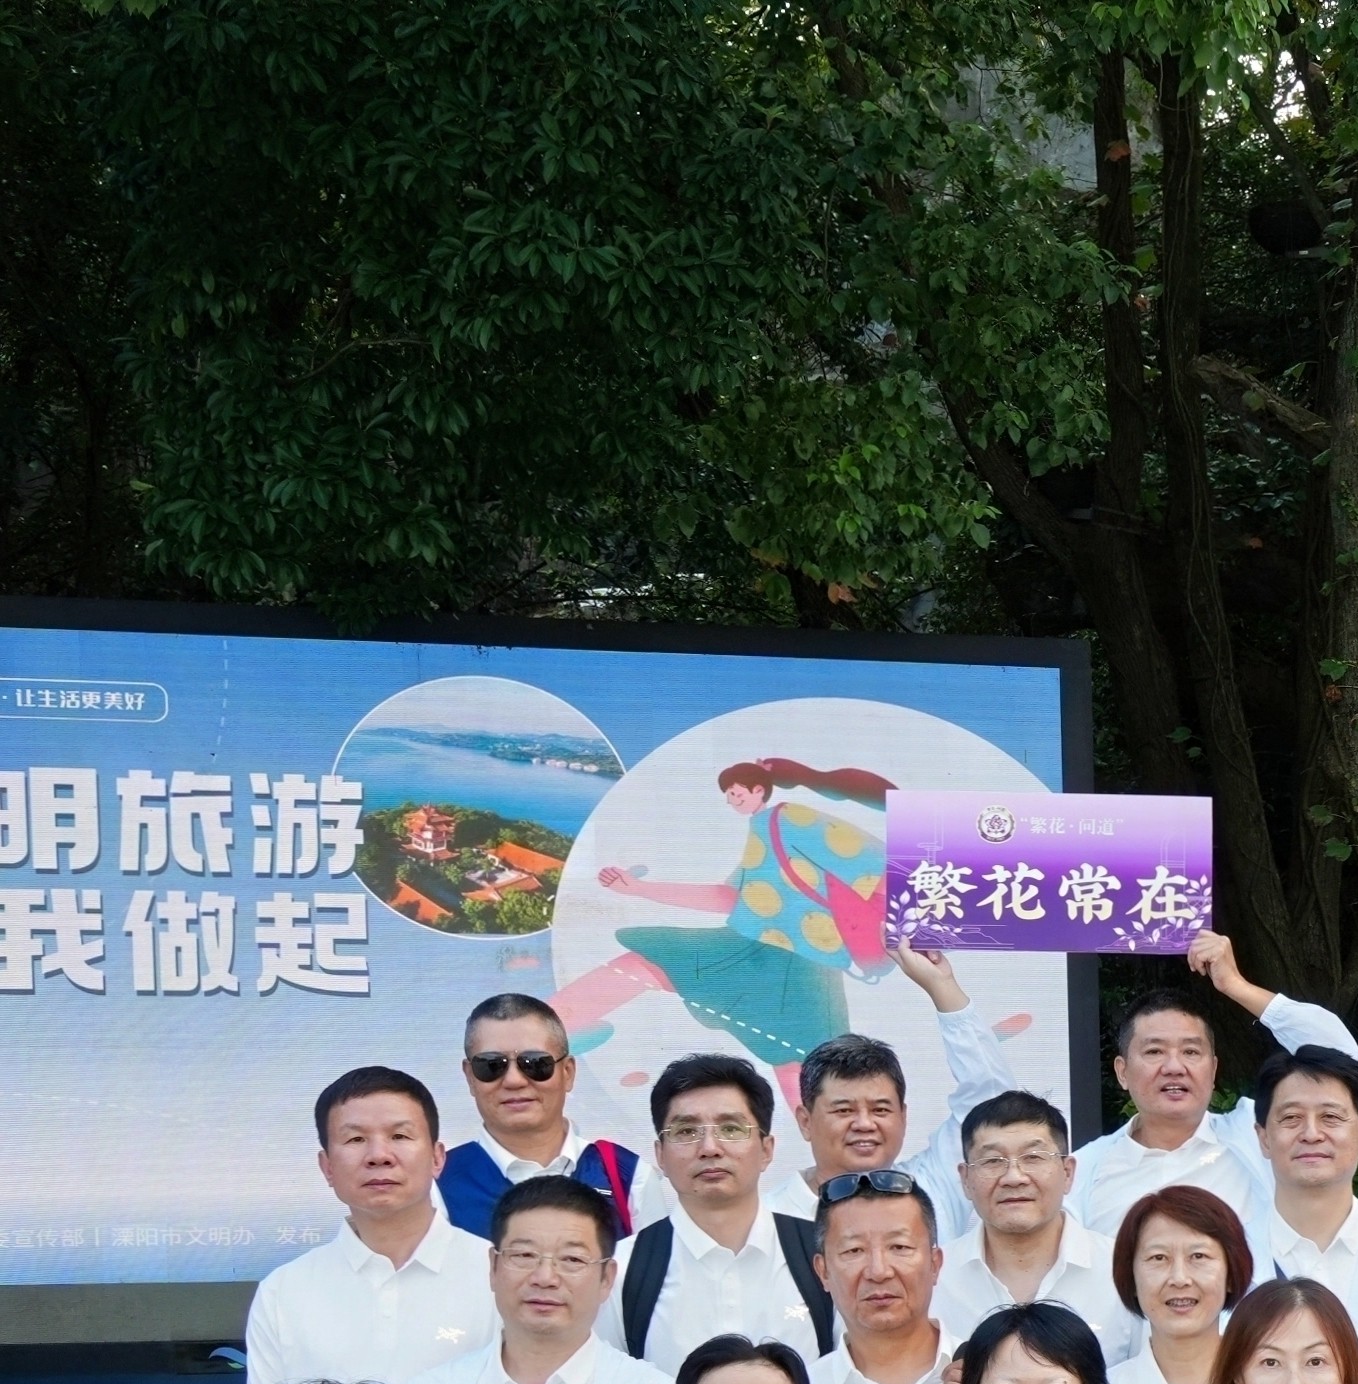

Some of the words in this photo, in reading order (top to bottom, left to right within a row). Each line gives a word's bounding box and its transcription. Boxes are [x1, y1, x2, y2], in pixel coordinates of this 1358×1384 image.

[0, 766, 364, 876] 明旅游
[907, 860, 1197, 925] 繁花常在
[0, 888, 370, 993] 我做起
[276, 1226, 321, 1246] 发布
